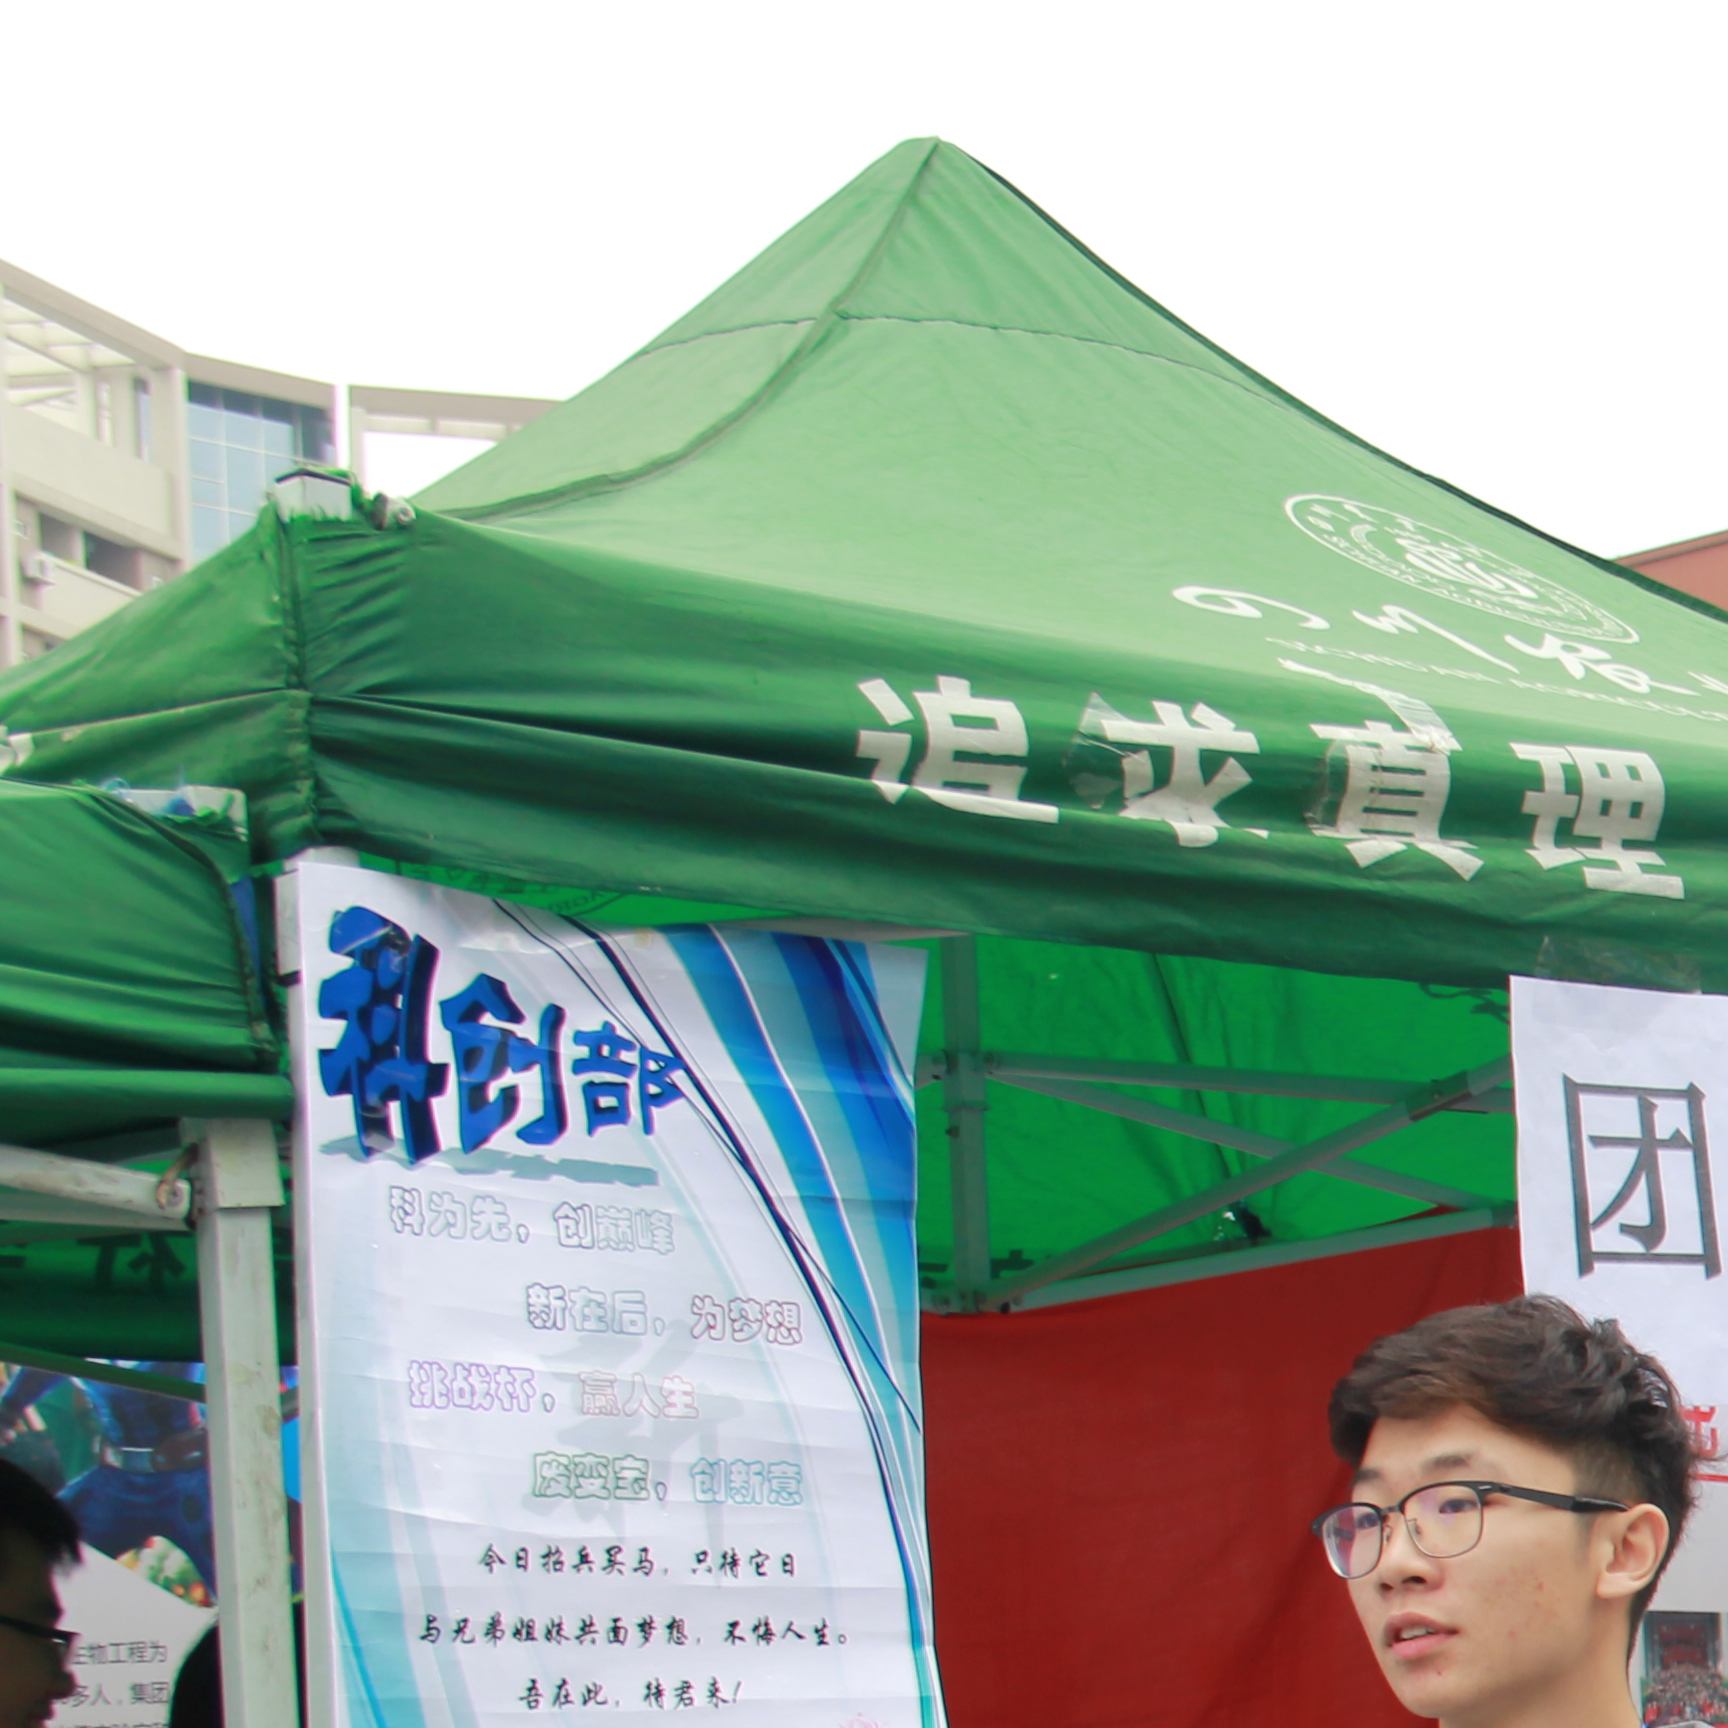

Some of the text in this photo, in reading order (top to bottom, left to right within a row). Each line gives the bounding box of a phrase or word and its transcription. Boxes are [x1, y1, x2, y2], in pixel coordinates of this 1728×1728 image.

[857, 675, 1684, 898] 追求真理
[318, 905, 685, 1164] 科创部
[1563, 1073, 1721, 1279] 团
